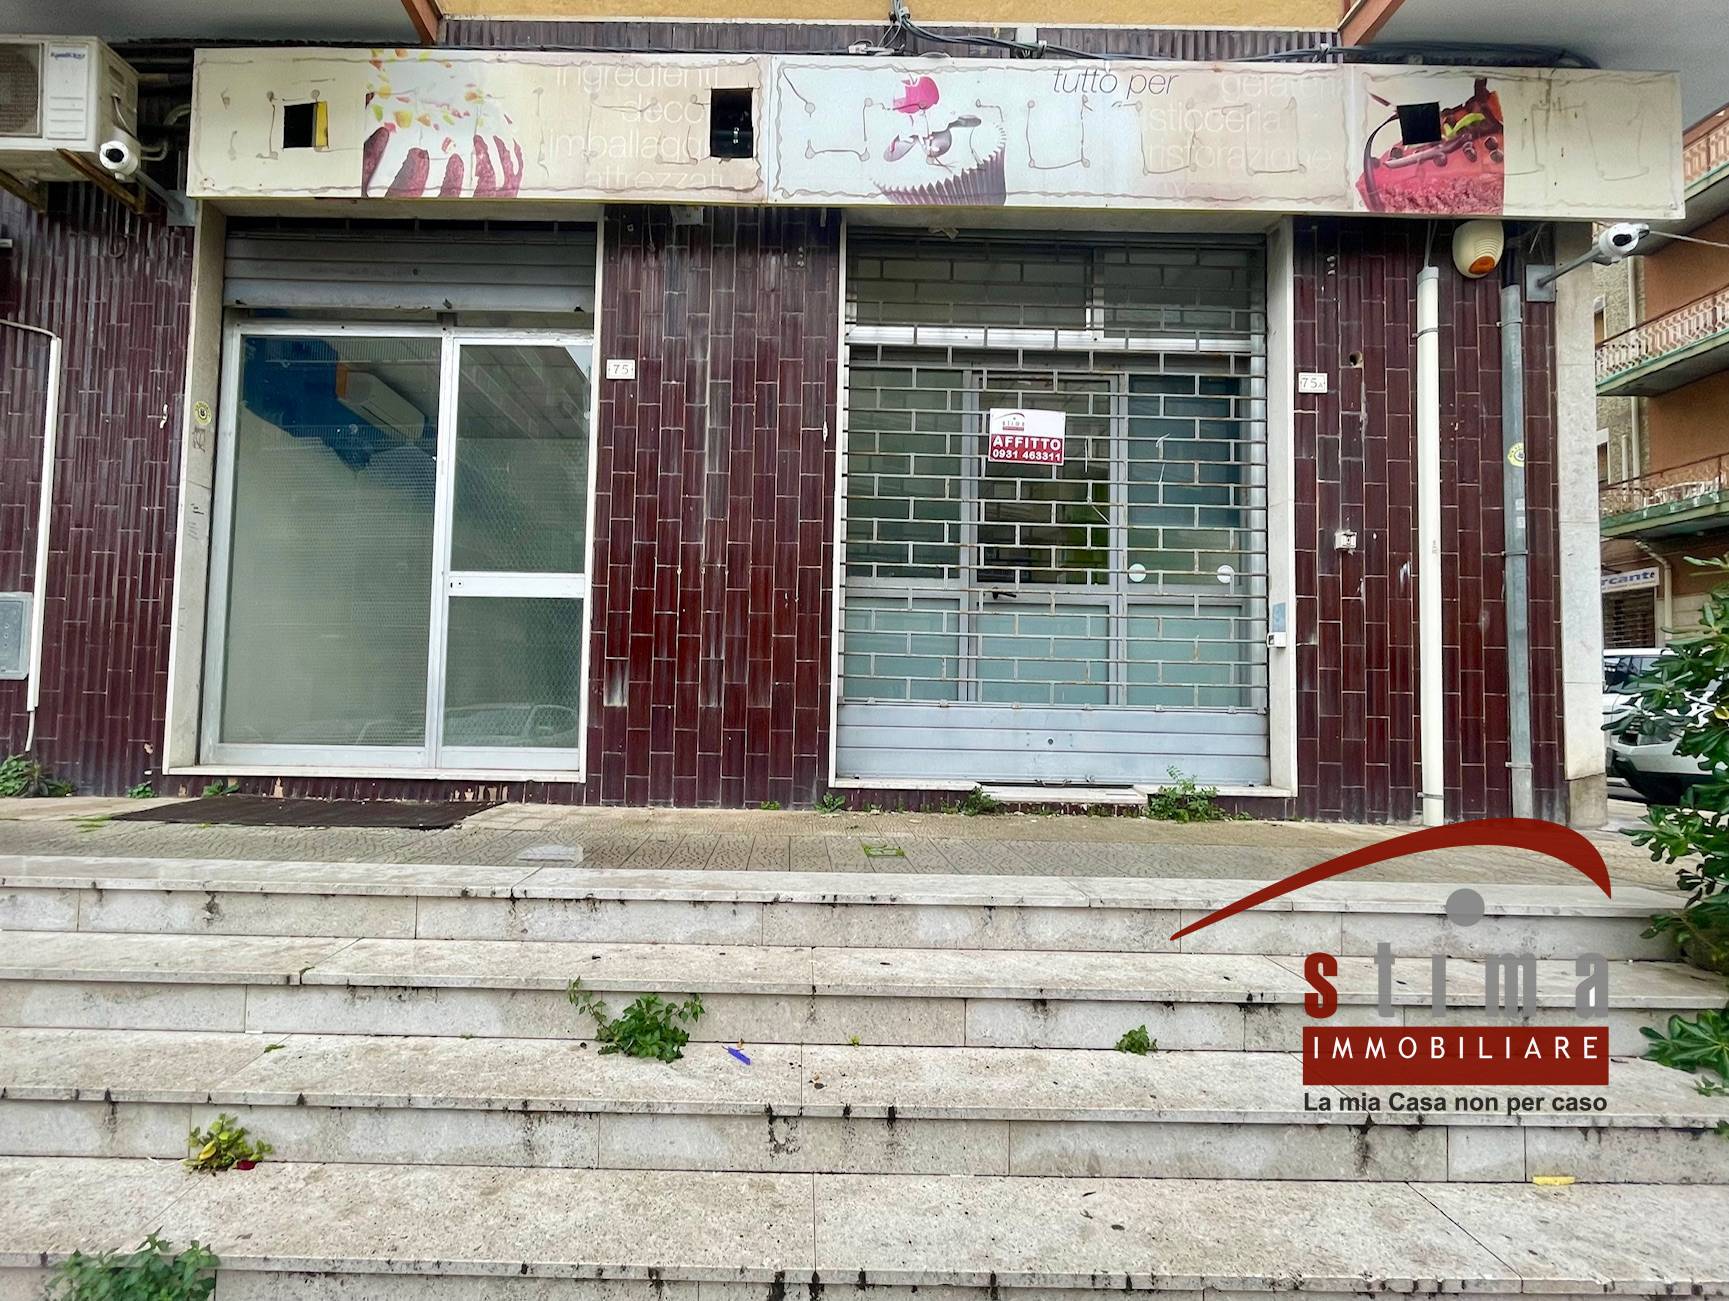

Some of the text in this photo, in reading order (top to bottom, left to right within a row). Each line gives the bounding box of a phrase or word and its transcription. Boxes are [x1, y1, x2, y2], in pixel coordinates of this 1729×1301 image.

[1053, 67, 1180, 100] tutto per
[613, 364, 629, 375] 75
[992, 435, 1061, 451] AFFITTO
[992, 448, 1061, 462] 0931 463311
